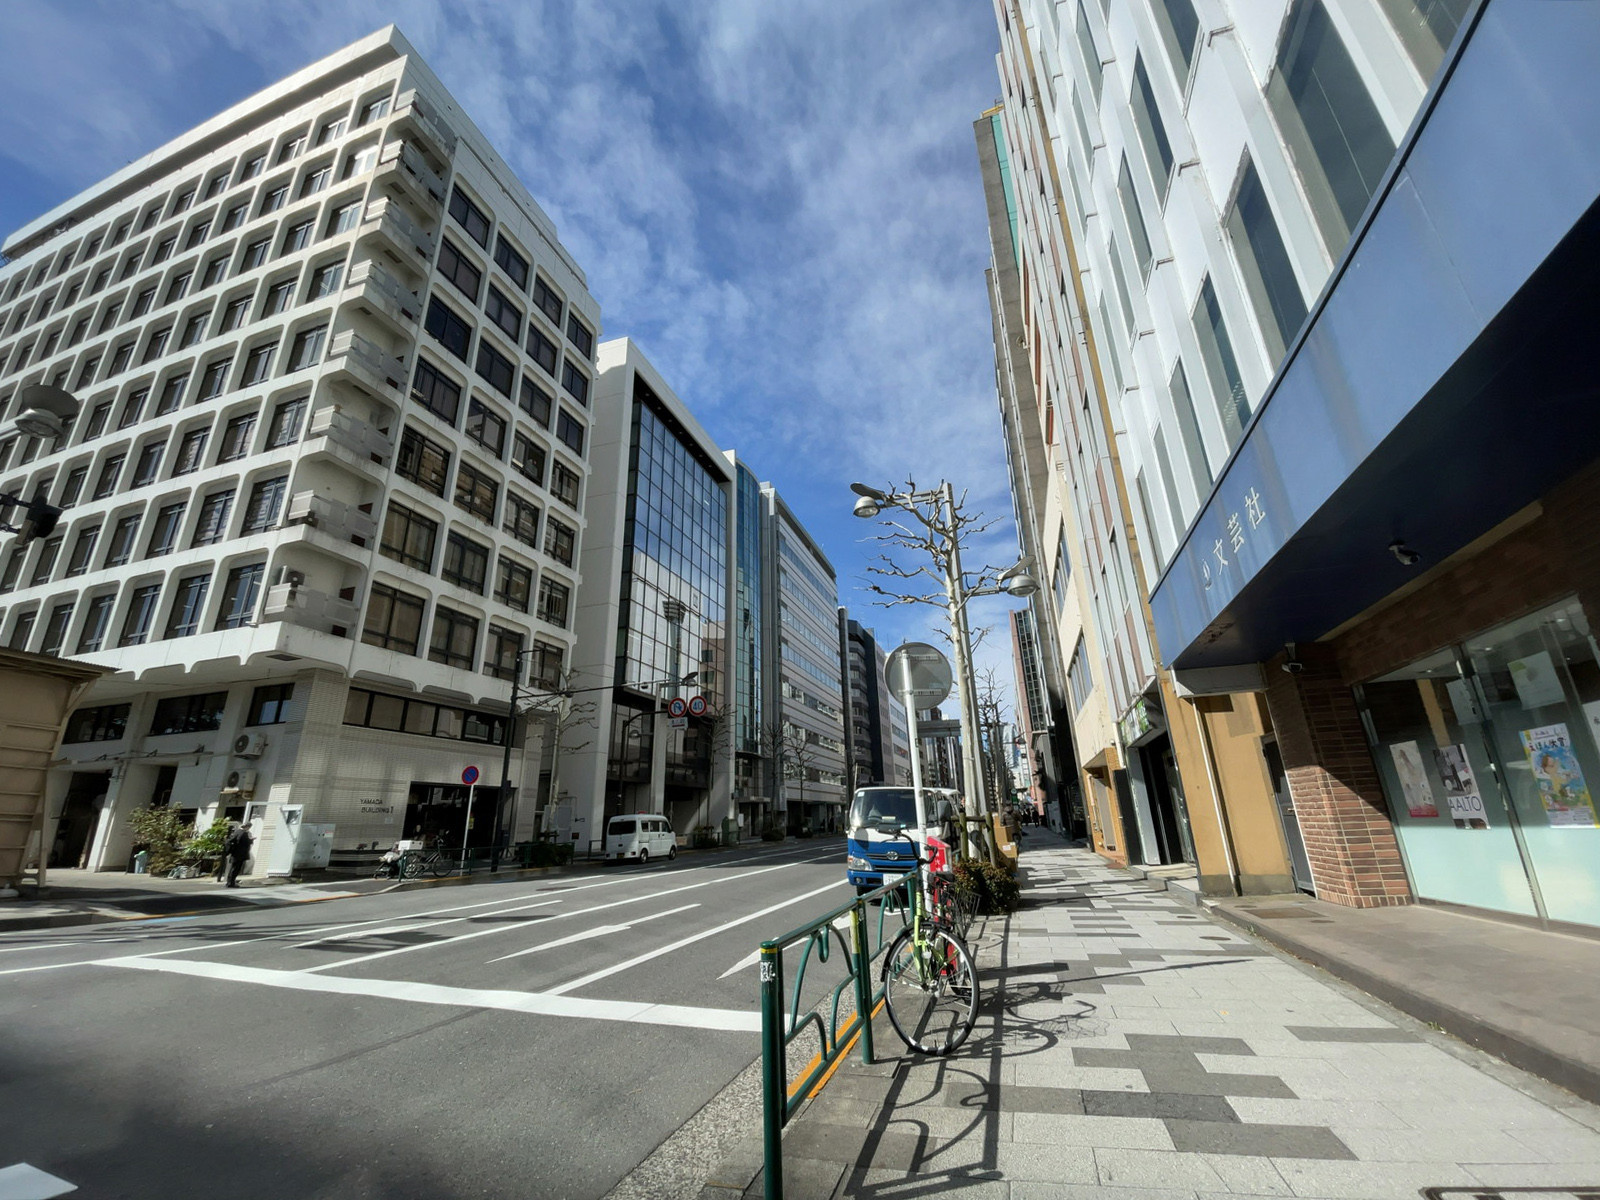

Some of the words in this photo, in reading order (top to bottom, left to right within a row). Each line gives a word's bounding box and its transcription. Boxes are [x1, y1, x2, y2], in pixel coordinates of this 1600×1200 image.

[1213, 486, 1266, 576] 文芸社
[693, 701, 703, 710] 40
[1448, 796, 1482, 812] AALTO
